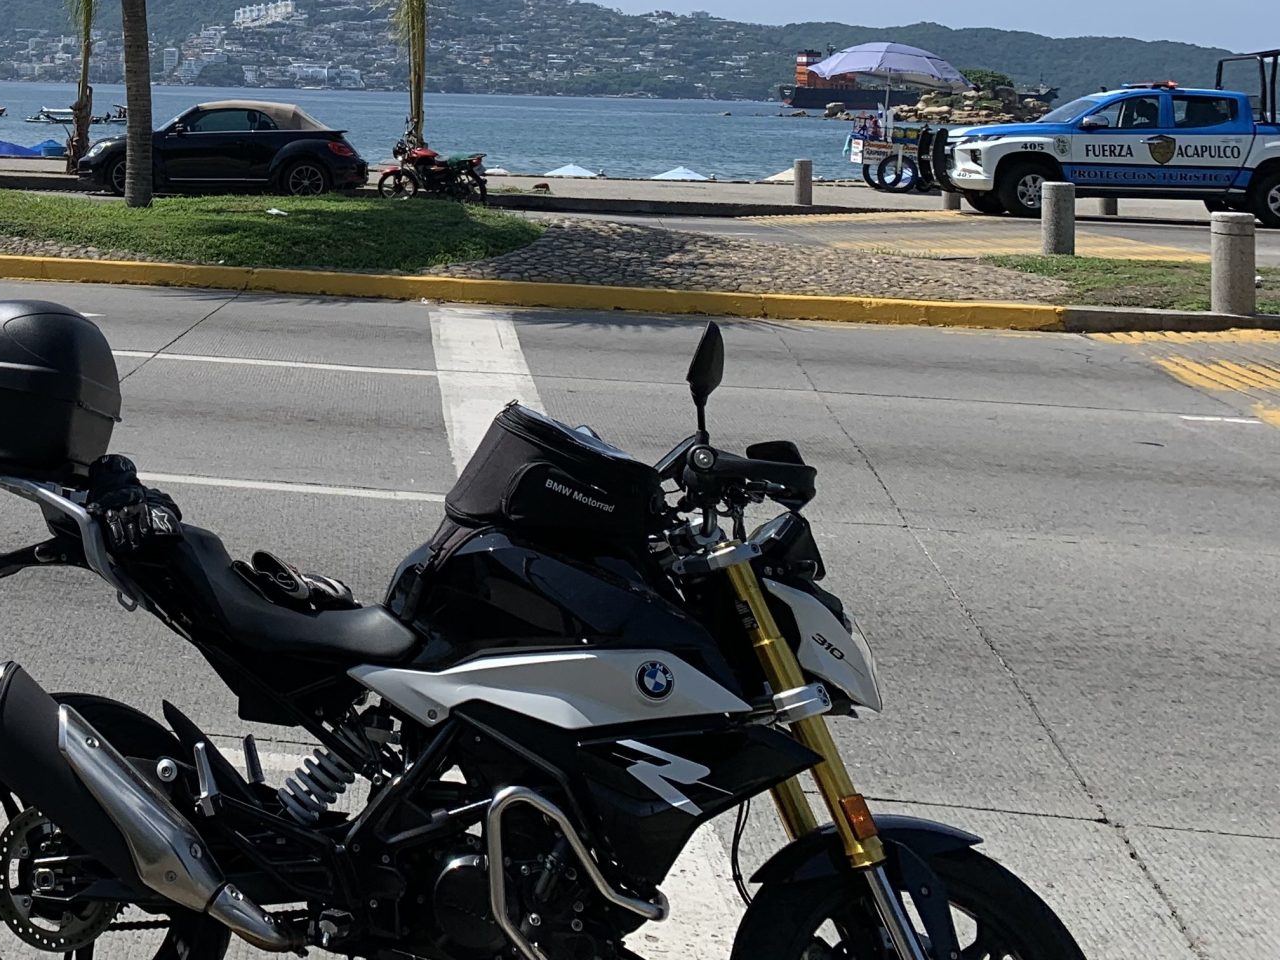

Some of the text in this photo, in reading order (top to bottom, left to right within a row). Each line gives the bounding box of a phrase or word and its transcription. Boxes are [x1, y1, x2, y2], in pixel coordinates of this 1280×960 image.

[1021, 142, 1045, 151] 405
[1085, 144, 1241, 159] FUERZA ACAPULCO
[545, 478, 615, 513] BMW Motorrad
[811, 633, 845, 660] 310
